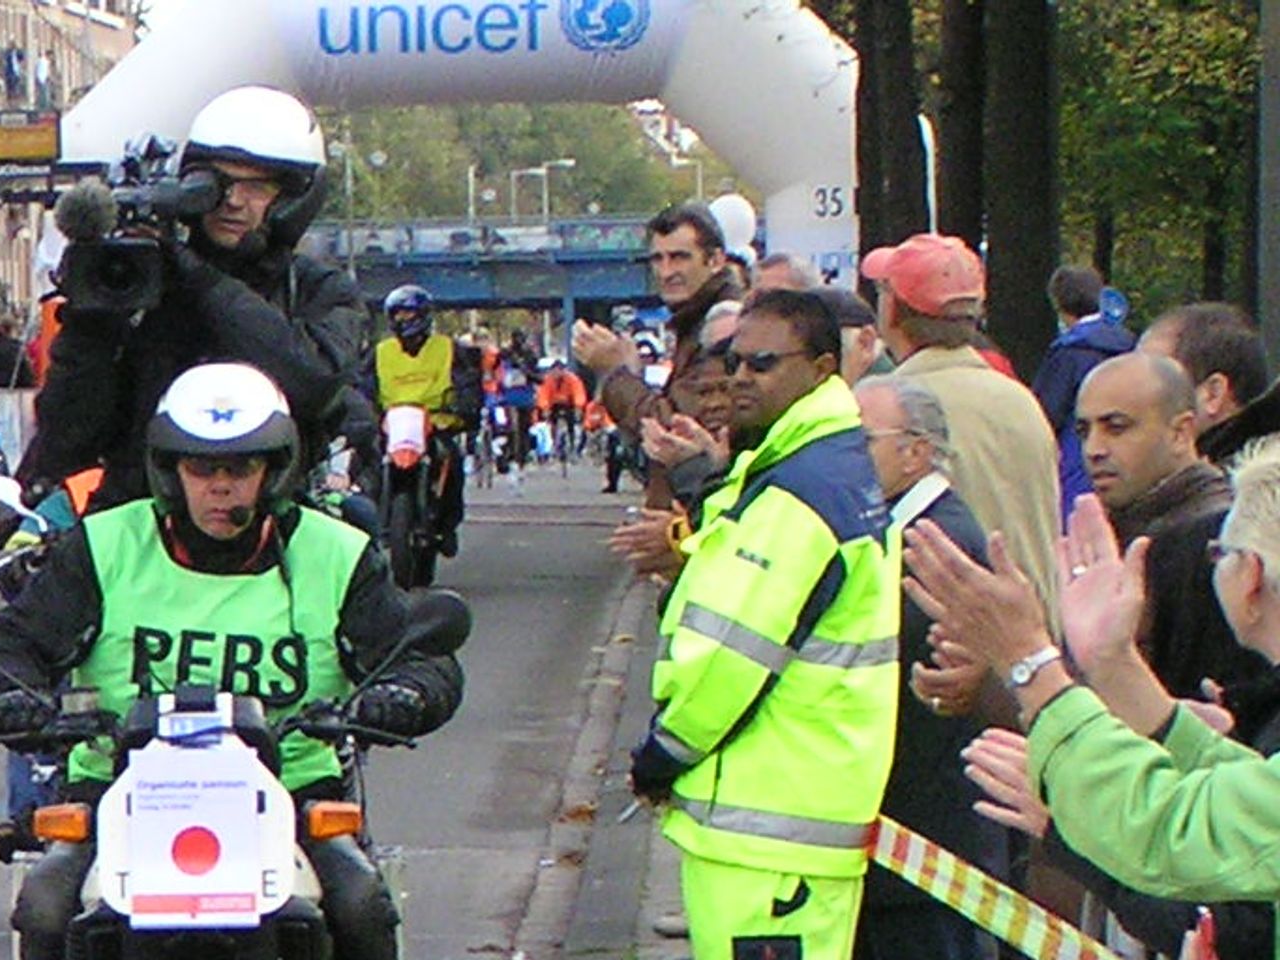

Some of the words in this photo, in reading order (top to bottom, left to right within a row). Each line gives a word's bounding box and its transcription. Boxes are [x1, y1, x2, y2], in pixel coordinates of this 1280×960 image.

[318, 0, 548, 54] unicef
[814, 187, 844, 217] 35
[130, 626, 308, 707] PERS
